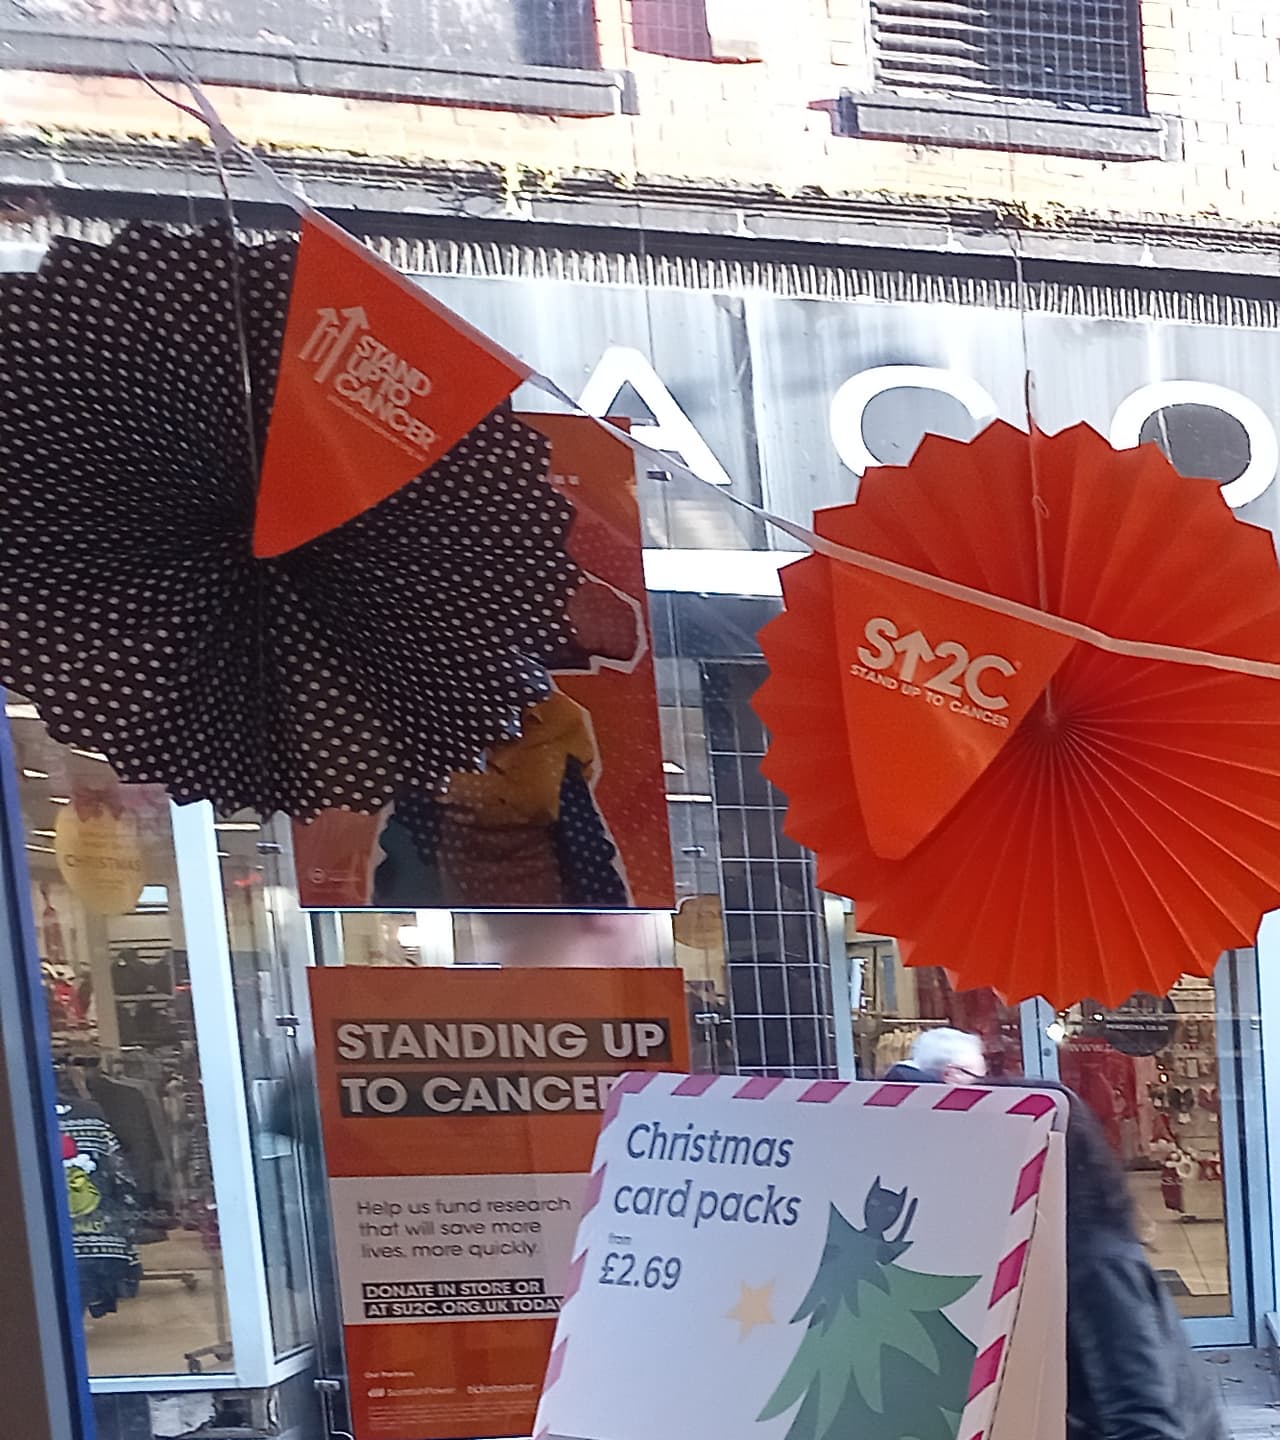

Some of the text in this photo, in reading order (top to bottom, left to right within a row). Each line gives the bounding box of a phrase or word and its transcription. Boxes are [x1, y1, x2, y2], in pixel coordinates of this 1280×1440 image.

[355, 335, 432, 397] STAND
[334, 373, 436, 450] CANCER
[850, 664, 1010, 729] STAND UP TO CANCER
[336, 1021, 667, 1063] STANDING UP
[341, 1076, 408, 1116] TO
[626, 1121, 795, 1168] Christmas
[357, 1197, 572, 1219] Help us fund research
[614, 1179, 802, 1229] card packs
[359, 1220, 541, 1238] that will save more
[608, 1232, 633, 1246] from
[412, 1244, 464, 1257] more
[366, 1280, 541, 1298] DONATE IN STORE OR
[599, 1252, 682, 1290] £2.69
[368, 1303, 387, 1316] AT
[392, 1300, 509, 1315] SU2C.ORG.UK
